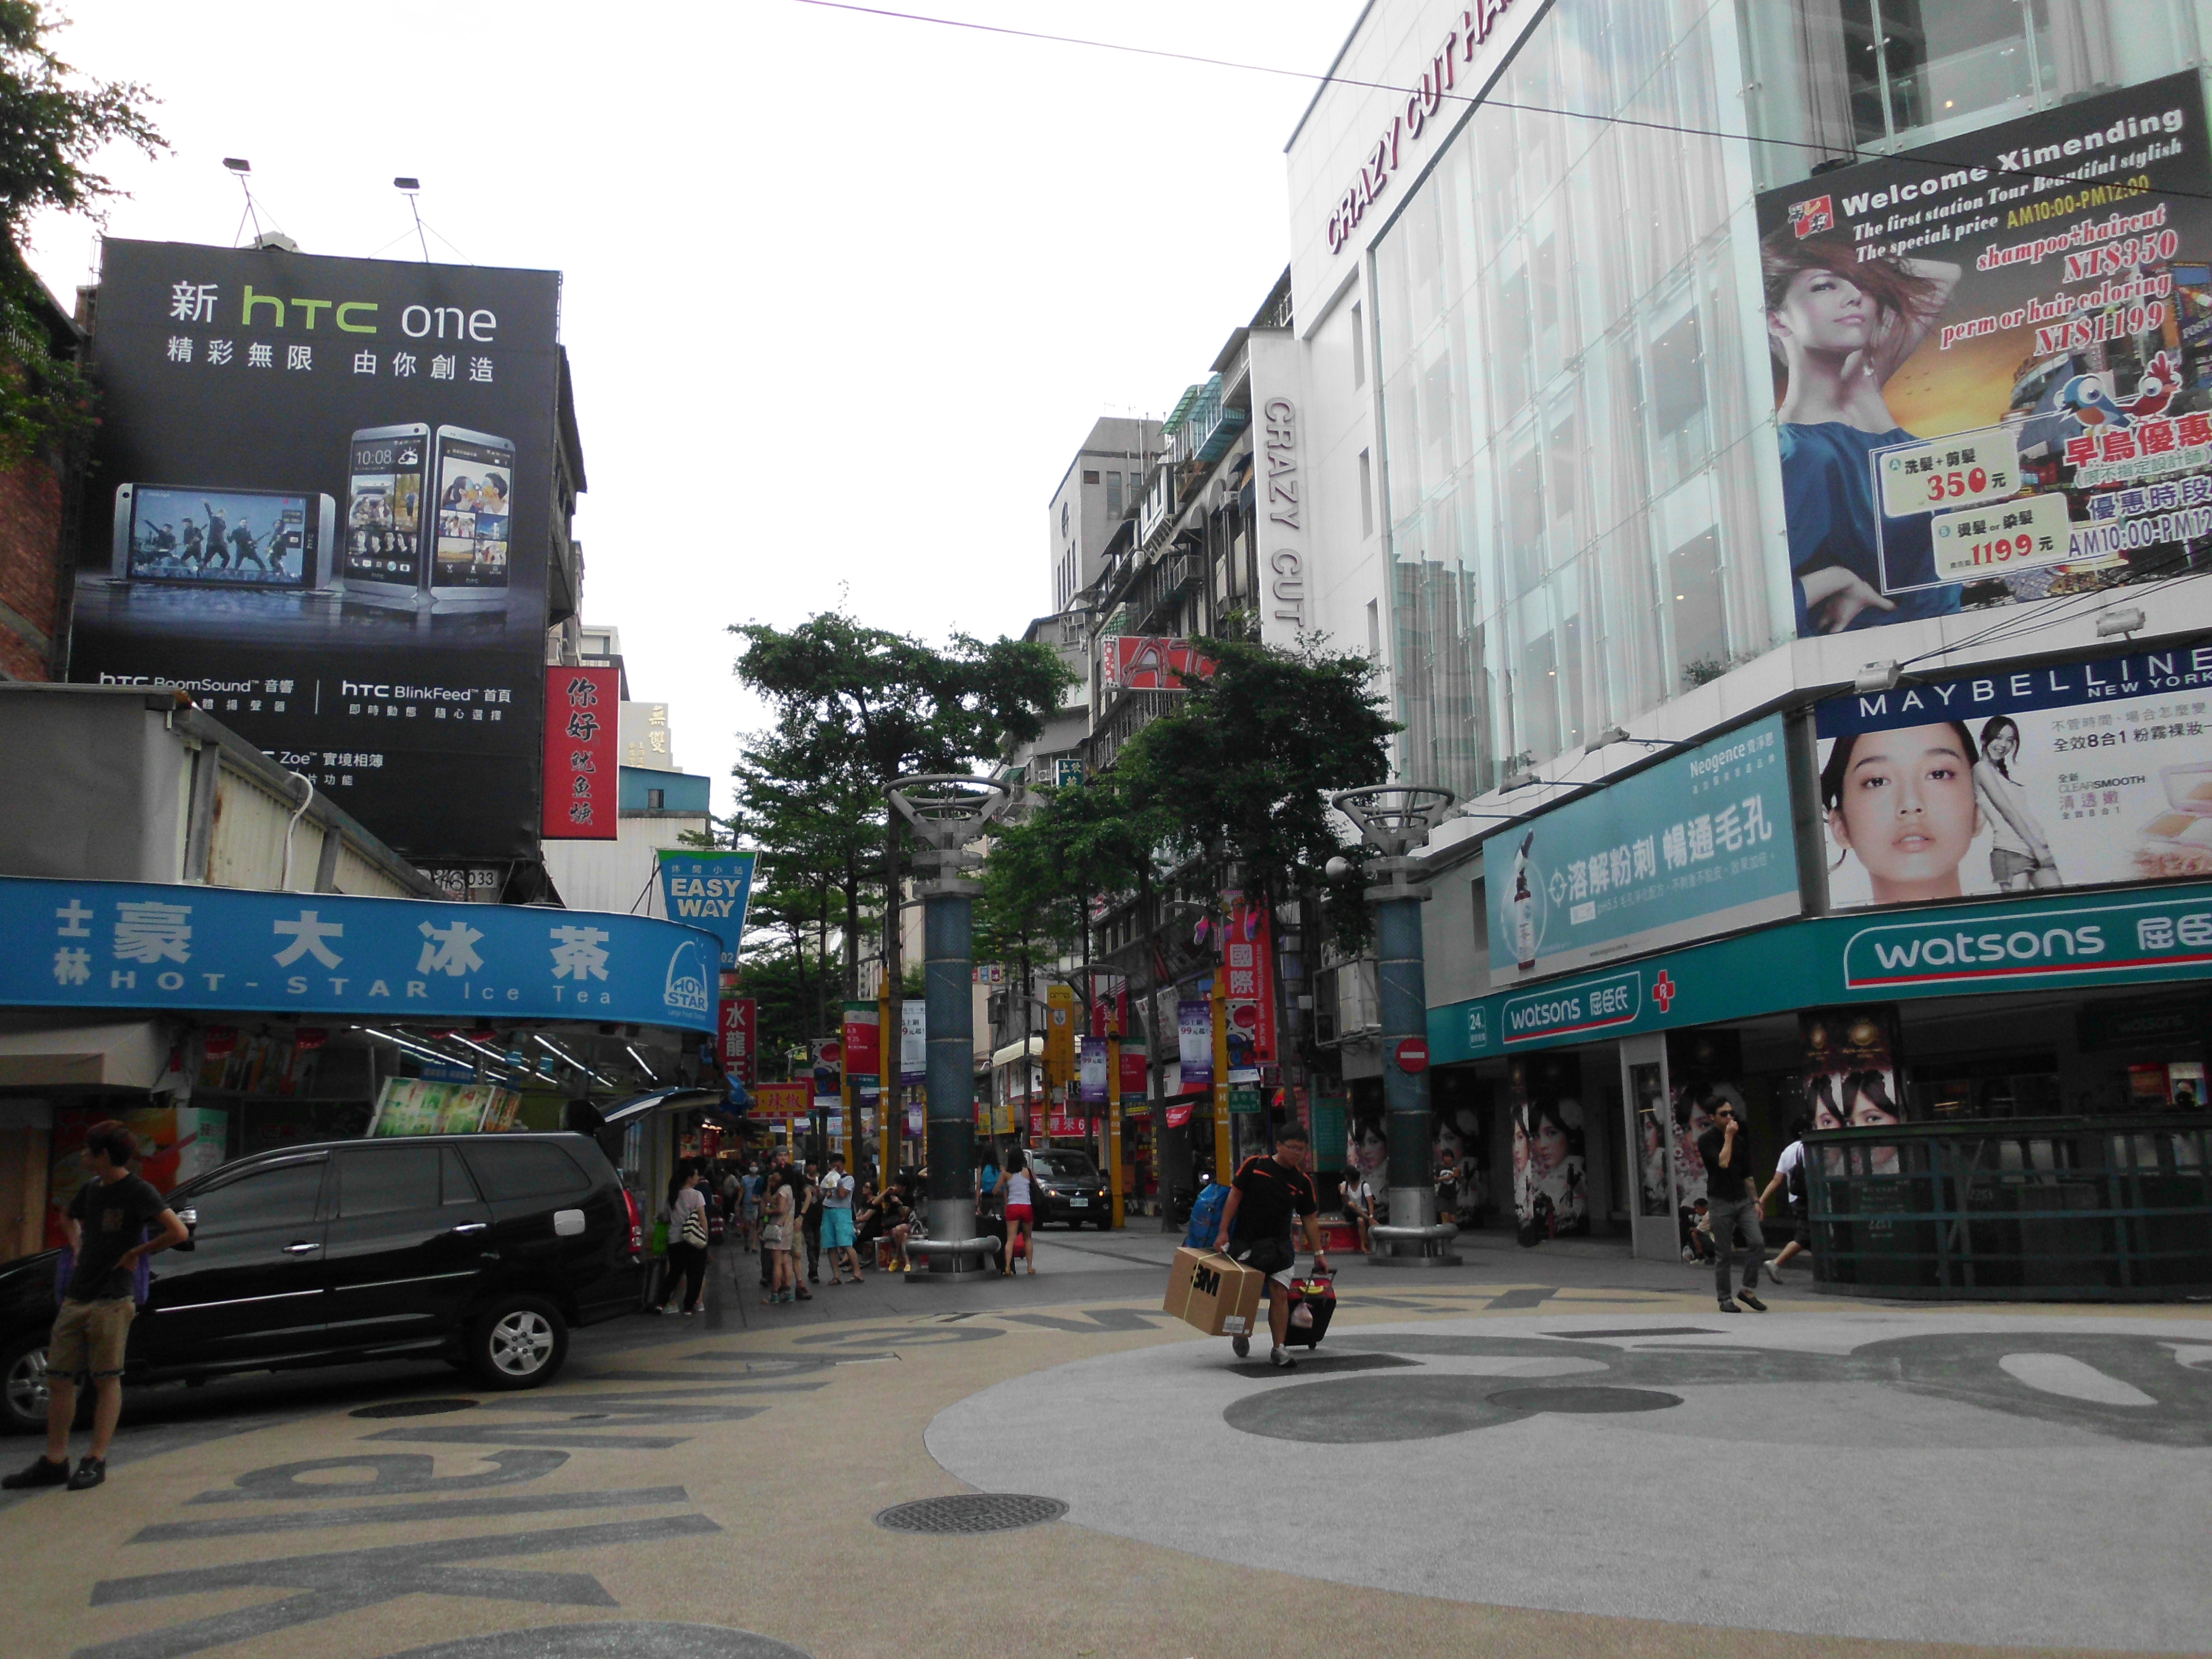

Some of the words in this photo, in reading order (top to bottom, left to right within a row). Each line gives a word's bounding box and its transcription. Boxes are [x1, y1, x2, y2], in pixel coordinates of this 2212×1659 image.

[1327, 116, 1400, 254] CRAZY
[1405, 32, 1457, 139] CUT
[1463, 0, 1514, 62] HA
[1842, 165, 1989, 217] Welcome
[1997, 109, 2183, 176] Ximending
[1853, 222, 1883, 241] The
[1887, 210, 1922, 232] first
[1925, 197, 1983, 222] station
[1988, 184, 2029, 205] Tour
[2033, 155, 2116, 193] Beautiful
[2120, 137, 2182, 169] stylish
[1856, 244, 1886, 263] The
[1954, 216, 1998, 242] price
[2062, 228, 2179, 283] NT$350
[169, 280, 218, 324] 新
[401, 304, 497, 342] one
[1940, 316, 1997, 350] perm
[1999, 307, 2025, 329] or
[2026, 290, 2075, 325] hair
[2077, 272, 2173, 313] coloring
[2033, 301, 2165, 357] NT$1199
[166, 335, 313, 372] 精彩無限
[352, 349, 495, 384] 由你創造
[356, 450, 392, 465] 10:08
[1265, 396, 1301, 529] CRAZY
[2066, 412, 2212, 467] 早鳥優惠
[1927, 466, 1987, 501] 350
[1991, 472, 2007, 488] 元
[2089, 475, 2211, 520] 優惠時段
[1971, 534, 2033, 566] 1199
[2038, 535, 2054, 551] 元
[1271, 547, 1305, 627] CUT
[483, 688, 512, 704] 首頁
[1859, 646, 2212, 718] MAYBELLINE
[2087, 681, 2139, 698] NEW
[2147, 671, 2212, 689] YORK
[1690, 743, 1746, 778] Neogence
[2053, 730, 2127, 753] 全效8合1
[671, 878, 741, 897] EASY
[1568, 834, 1655, 901] 溶解粉刺
[677, 899, 735, 918] WAY
[53, 899, 94, 986] 士林
[112, 901, 610, 981] 豪大冰茶
[1874, 925, 2104, 969] watsons
[673, 979, 704, 995] HOT
[1230, 945, 1253, 993] 國際
[463, 982, 519, 1001] Ice
[552, 985, 611, 1005] Tea
[668, 991, 705, 1010] STAR
[1511, 997, 1581, 1030] watsons
[1590, 985, 1628, 1016] 屈臣氏
[1190, 1263, 1221, 1297] 3M
